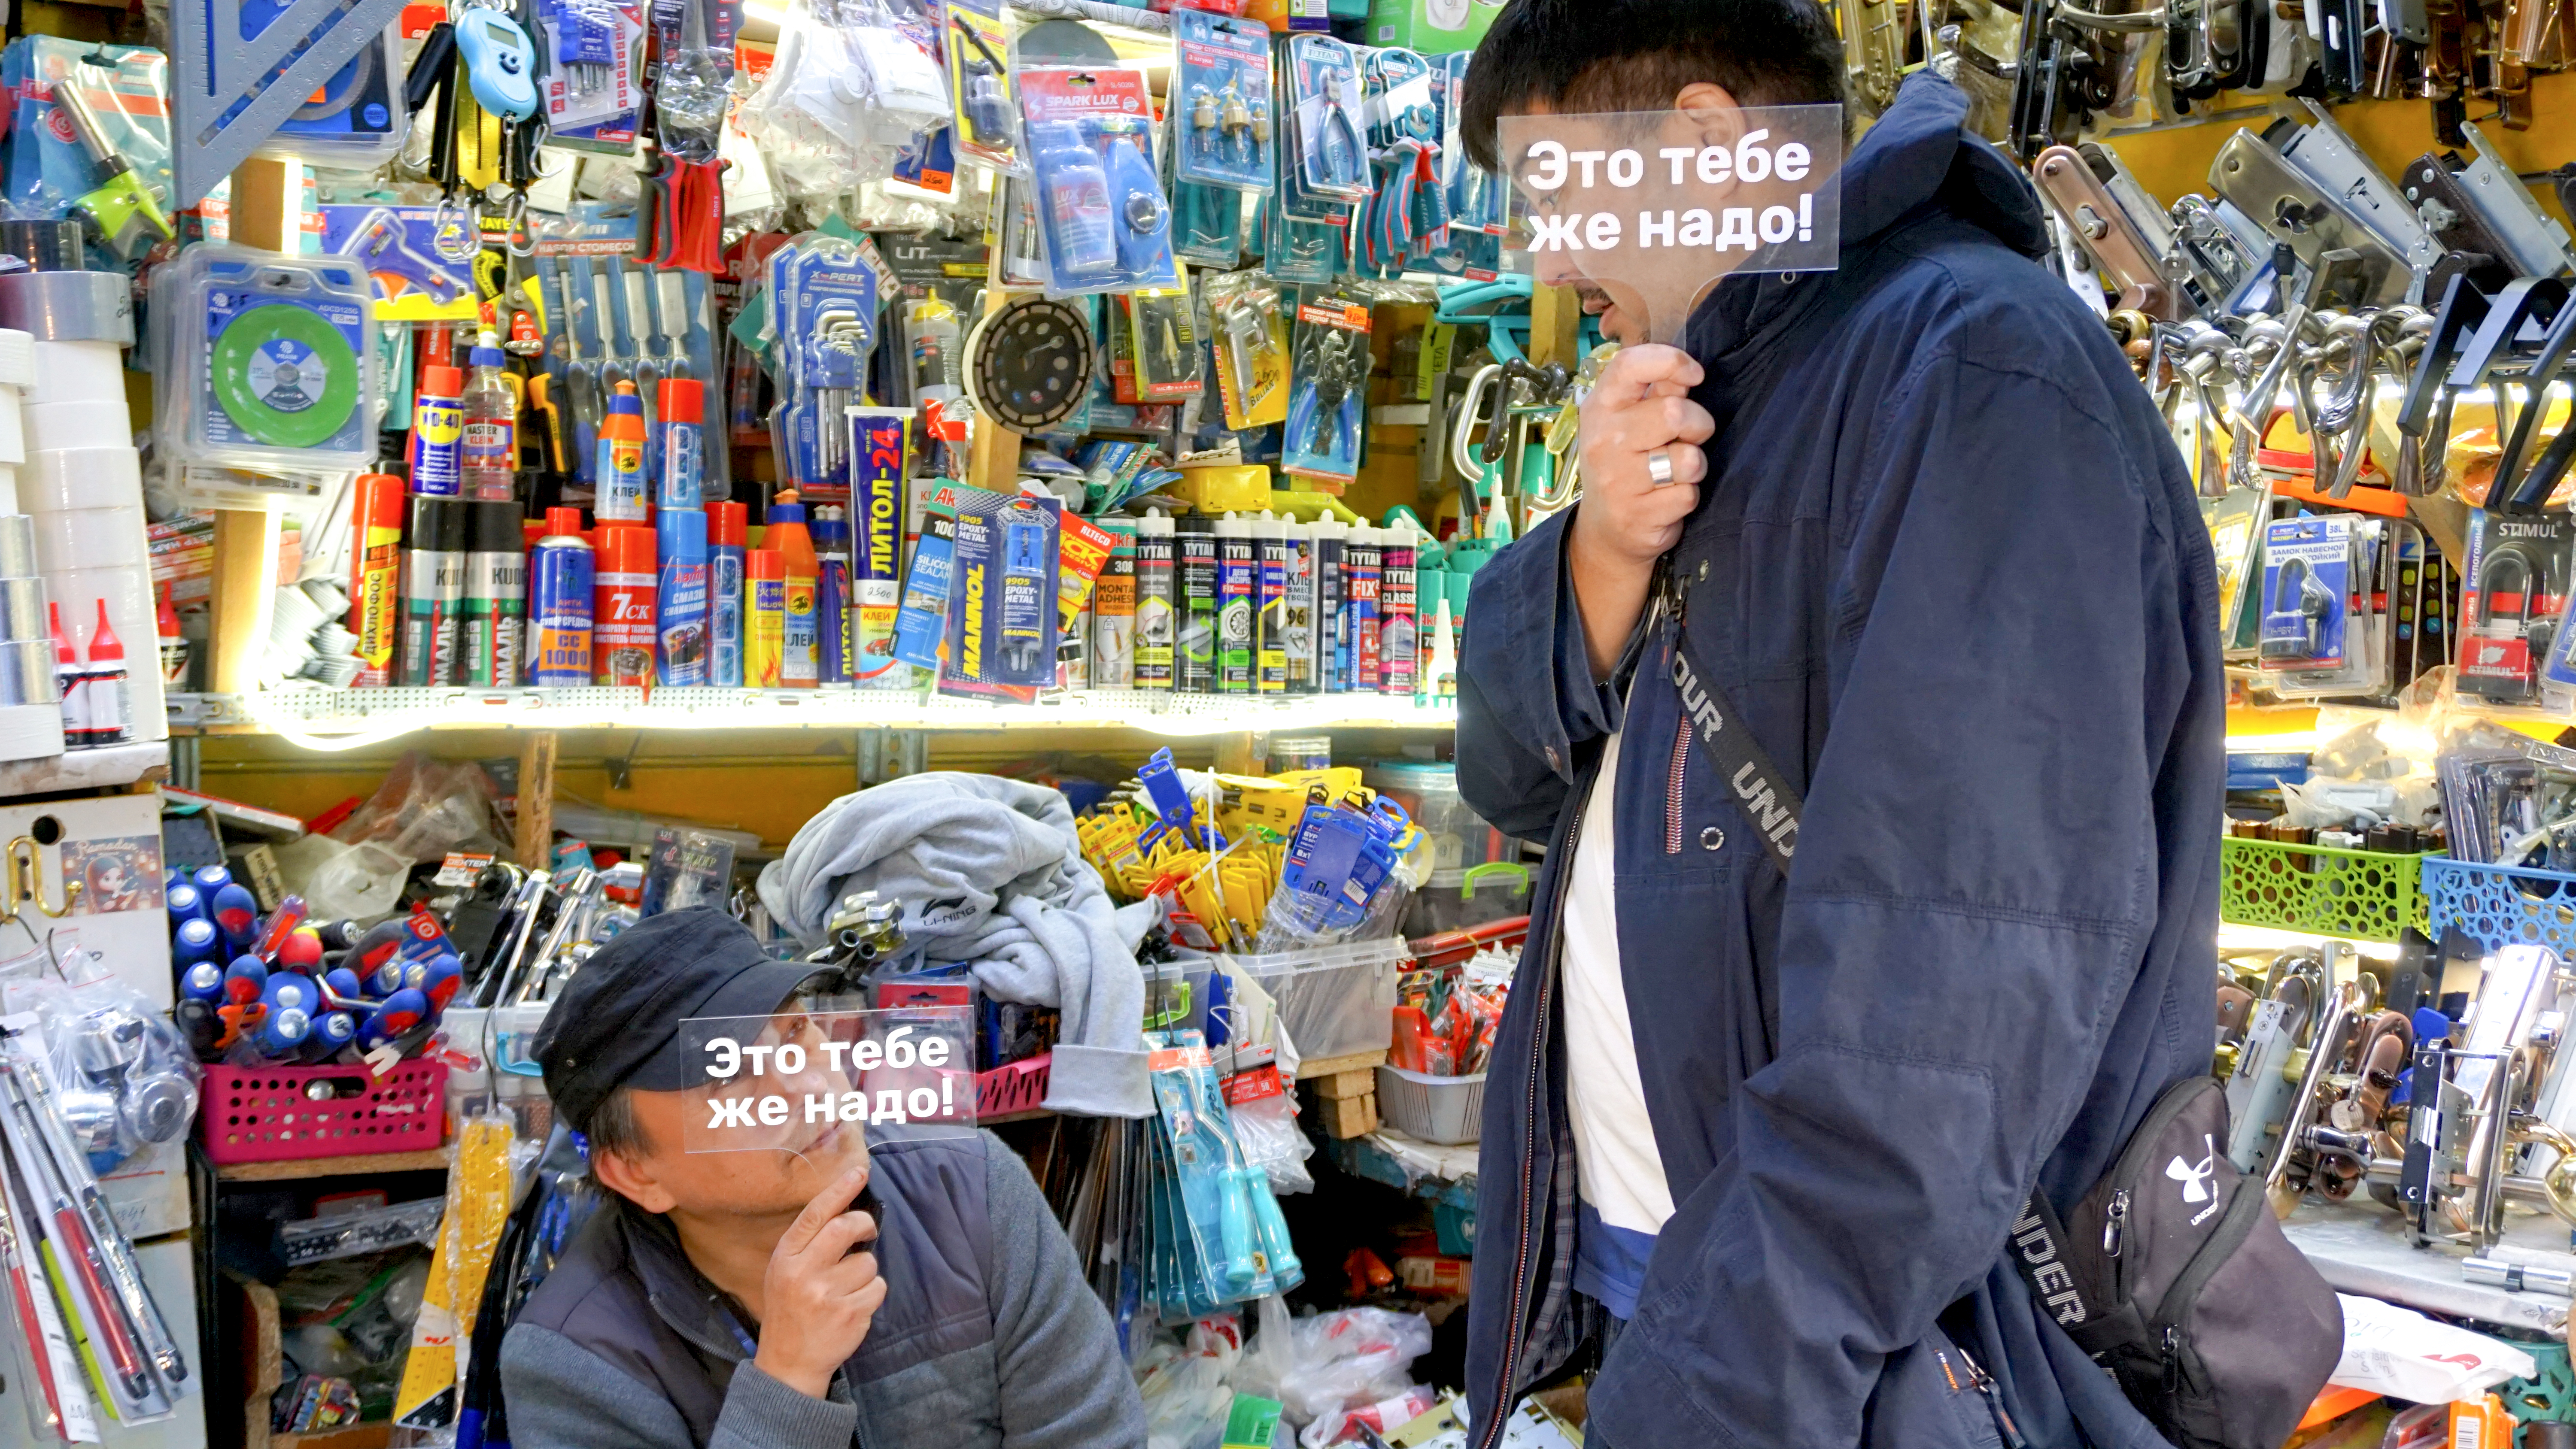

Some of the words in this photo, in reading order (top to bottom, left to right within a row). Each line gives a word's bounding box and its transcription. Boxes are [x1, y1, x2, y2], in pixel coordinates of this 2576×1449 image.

[1045, 95, 1091, 107] SPARK
[1093, 94, 1119, 105] LUX
[1528, 140, 1643, 191] Это
[1659, 128, 1811, 185] тебе
[1528, 211, 1622, 253] же
[1639, 193, 1813, 253] надо!
[895, 246, 931, 260] LIT
[422, 411, 460, 429] WD-40
[611, 485, 641, 497] КЛЕЙ
[871, 428, 900, 575] ЛИТОЛ-24
[958, 514, 983, 524] 9905
[958, 522, 990, 533] EPOXY-
[2498, 522, 2559, 538] STIMUL
[957, 530, 987, 543] METAL
[1137, 545, 1171, 559] TYTAN
[2271, 548, 2300, 556] ЗАМОК
[2302, 544, 2345, 554] НАВЕСНОЙ
[2470, 521, 2484, 588] ВСЕПОГОДНЫЙ
[1351, 552, 1381, 567] TYTAN
[1115, 561, 1133, 573] 308
[1005, 577, 1030, 586] 9905
[1005, 586, 1038, 595] EPOXY-
[1004, 595, 1035, 604] METAL
[363, 572, 383, 657] ДИХЛОФОС
[863, 609, 890, 621] КЛЕЙ
[962, 564, 985, 679] MANNOL
[1002, 629, 1040, 639] MANNOL
[545, 649, 588, 666] 1000
[2467, 665, 2514, 677] STIMUL
[446, 858, 488, 867] DEXTER
[923, 905, 978, 927] LI-NING
[705, 1037, 806, 1078] Это
[820, 1026, 949, 1072] тебе
[707, 1094, 788, 1129] же
[804, 1076, 954, 1126] надо!
